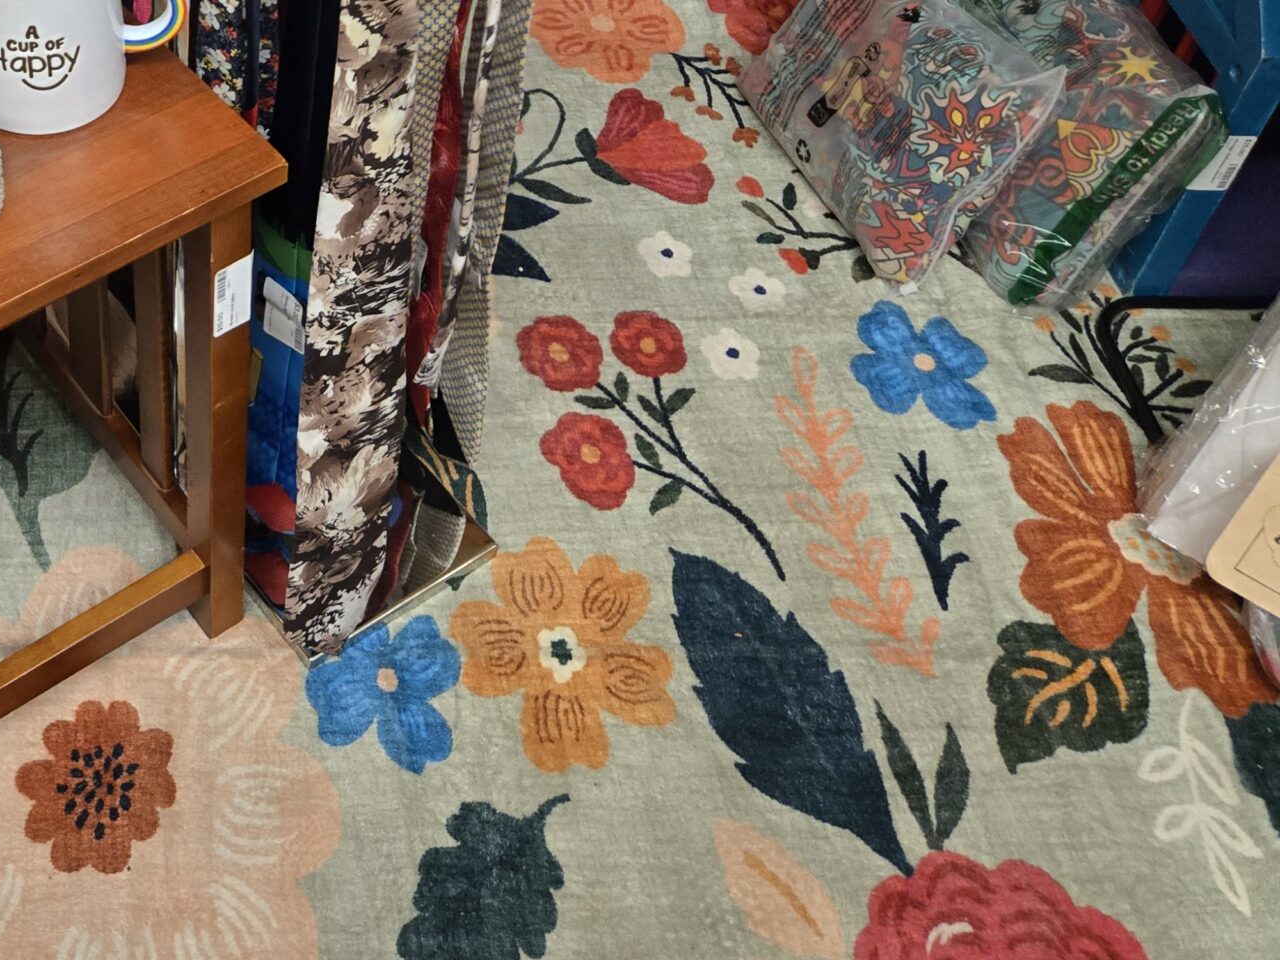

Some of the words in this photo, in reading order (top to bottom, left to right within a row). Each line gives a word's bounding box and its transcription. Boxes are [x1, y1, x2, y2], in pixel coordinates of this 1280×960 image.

[25, 25, 40, 40] A
[6, 39, 39, 52] CUP
[45, 37, 65, 51] OF
[1140, 102, 1201, 155] Ready
[1126, 155, 1150, 172] to
